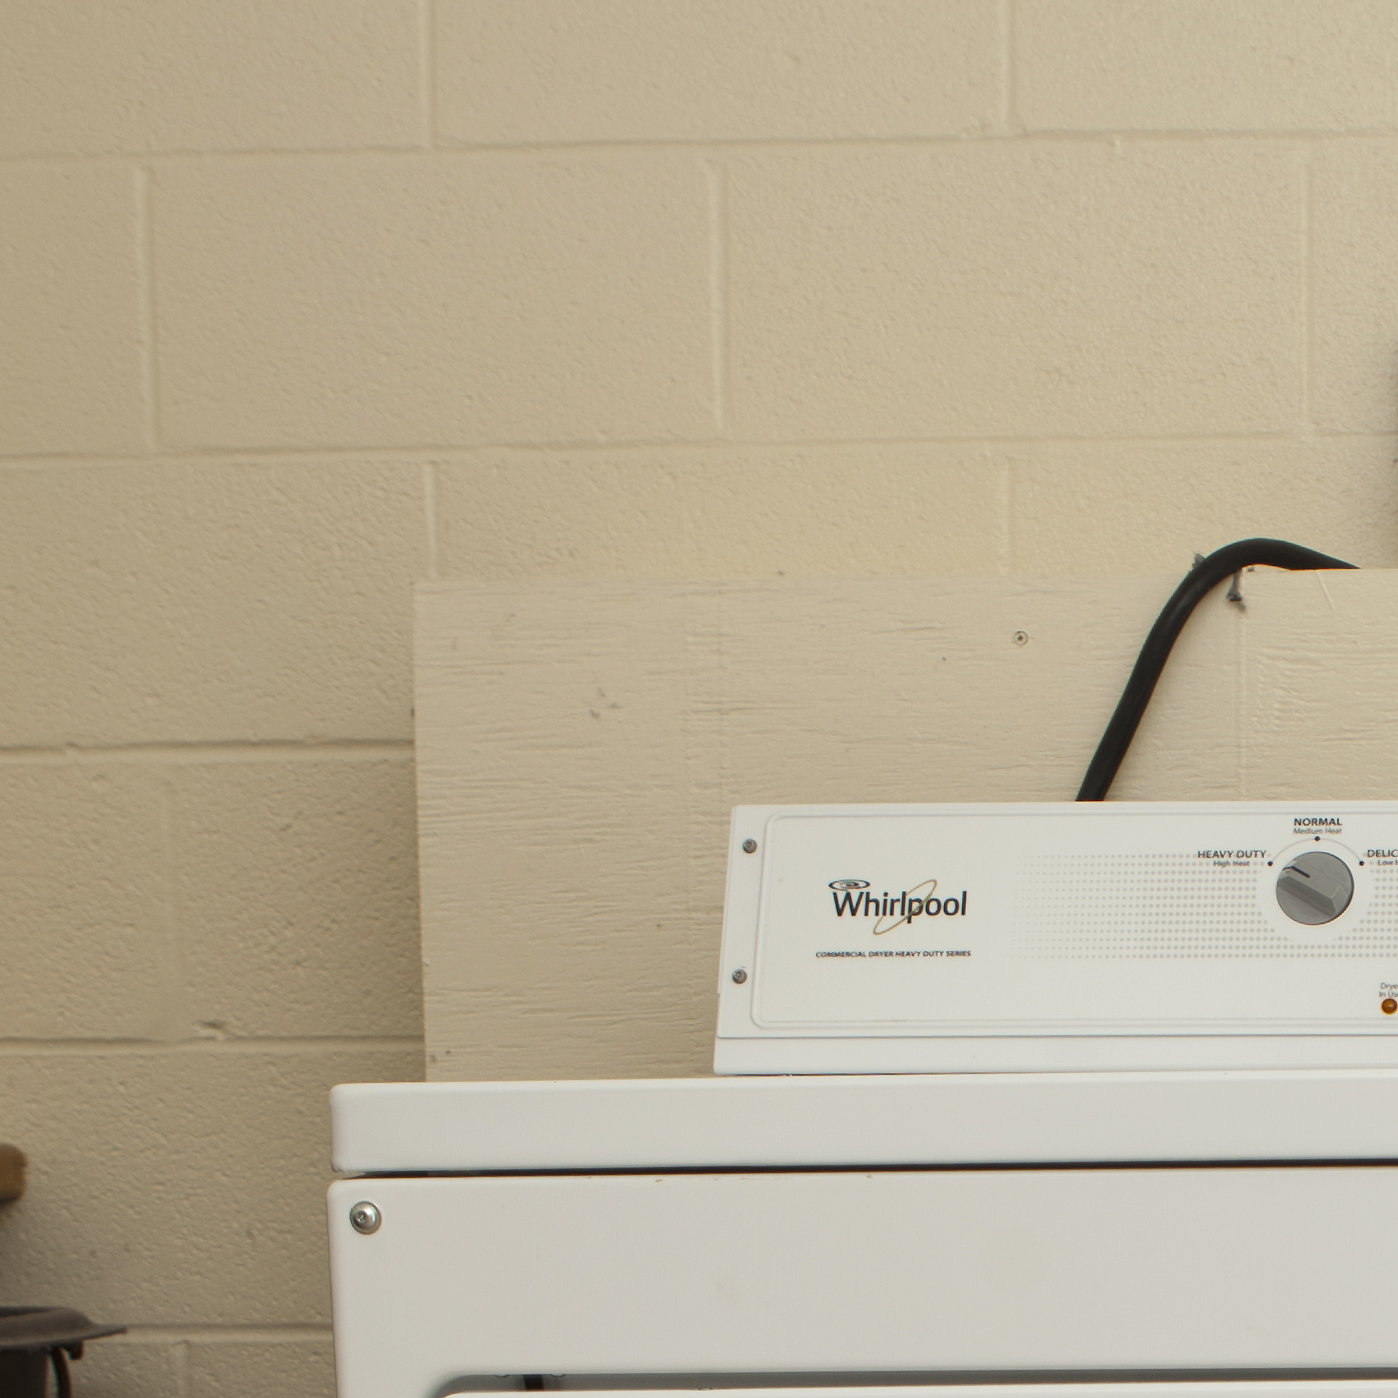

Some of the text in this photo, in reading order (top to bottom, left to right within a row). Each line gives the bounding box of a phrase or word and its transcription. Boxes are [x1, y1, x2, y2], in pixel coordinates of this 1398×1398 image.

[1294, 818, 1342, 826] NORMAL
[1198, 850, 1266, 858] HEAVY DUTY
[832, 891, 967, 924] Whirlpool
